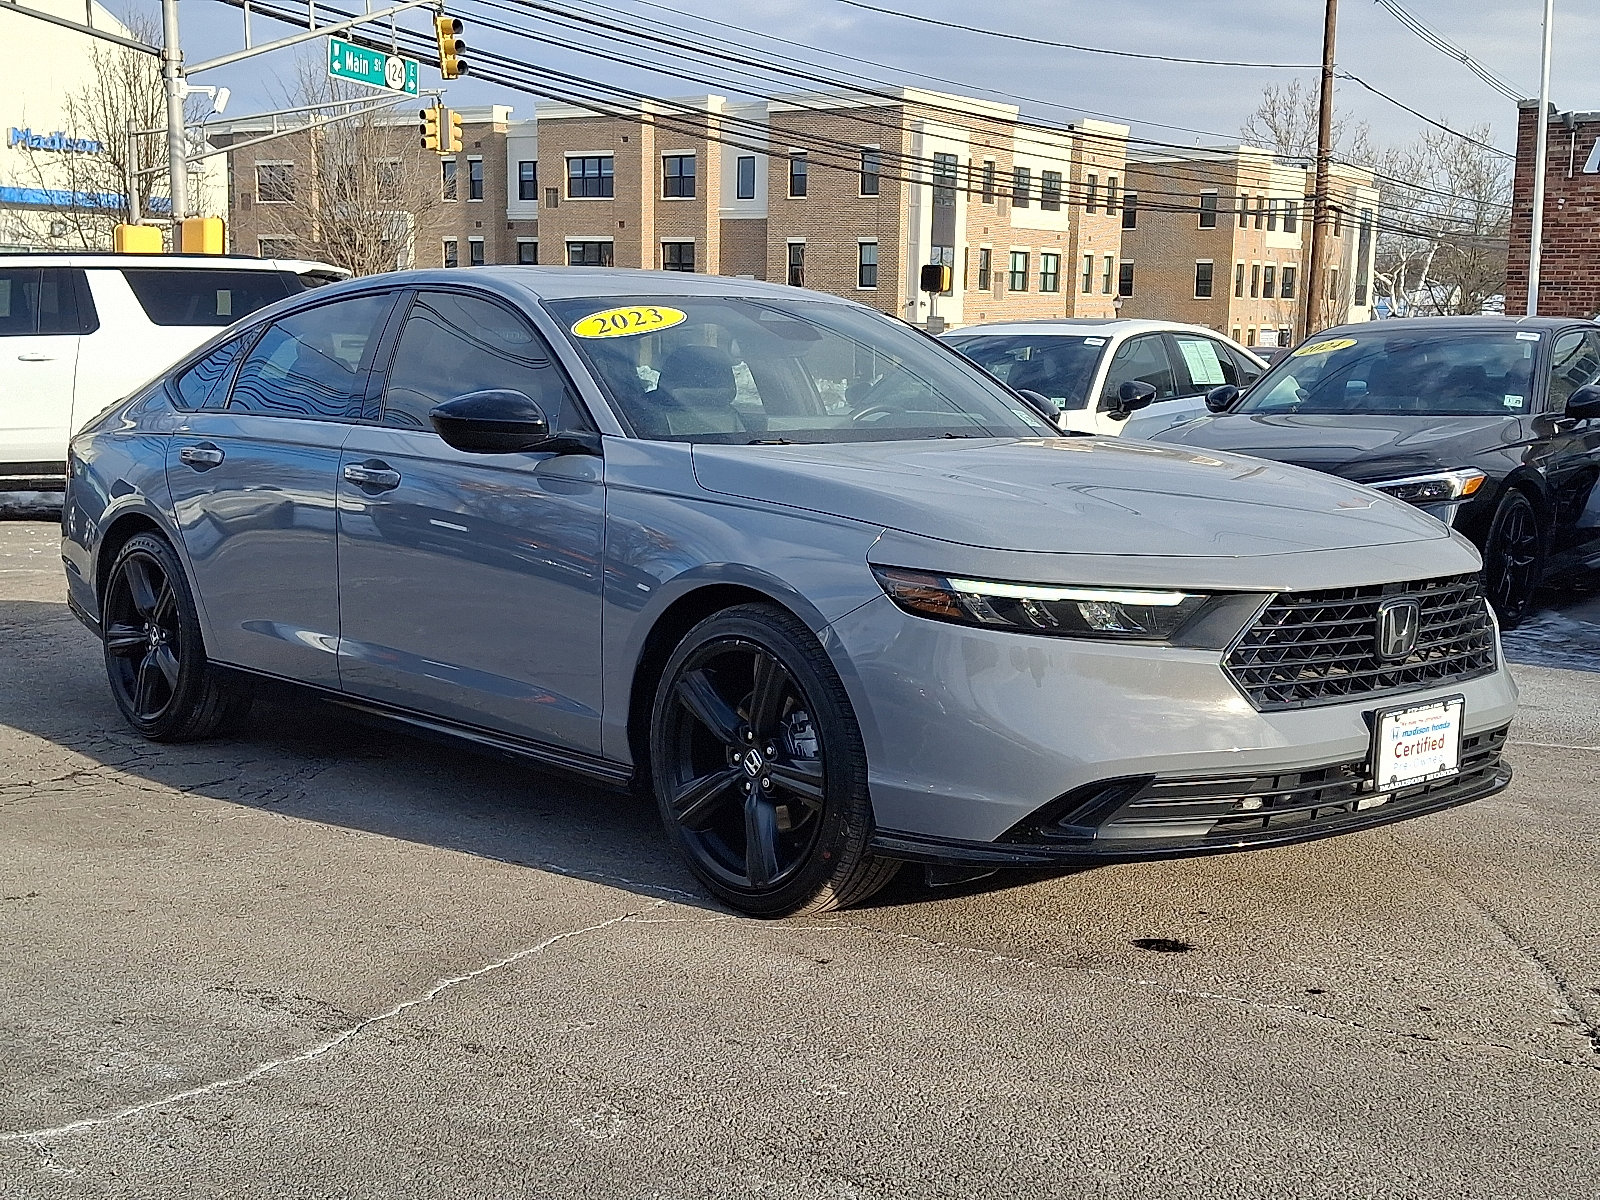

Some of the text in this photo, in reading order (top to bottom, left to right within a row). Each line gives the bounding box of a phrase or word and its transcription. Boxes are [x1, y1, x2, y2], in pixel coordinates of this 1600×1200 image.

[345, 50, 382, 76] Main St
[387, 62, 403, 84] 124
[592, 308, 663, 335] 2023
[1402, 726, 1430, 738] madison
[1394, 733, 1445, 758] Certified
[1379, 767, 1460, 792] MADISON HONDA
